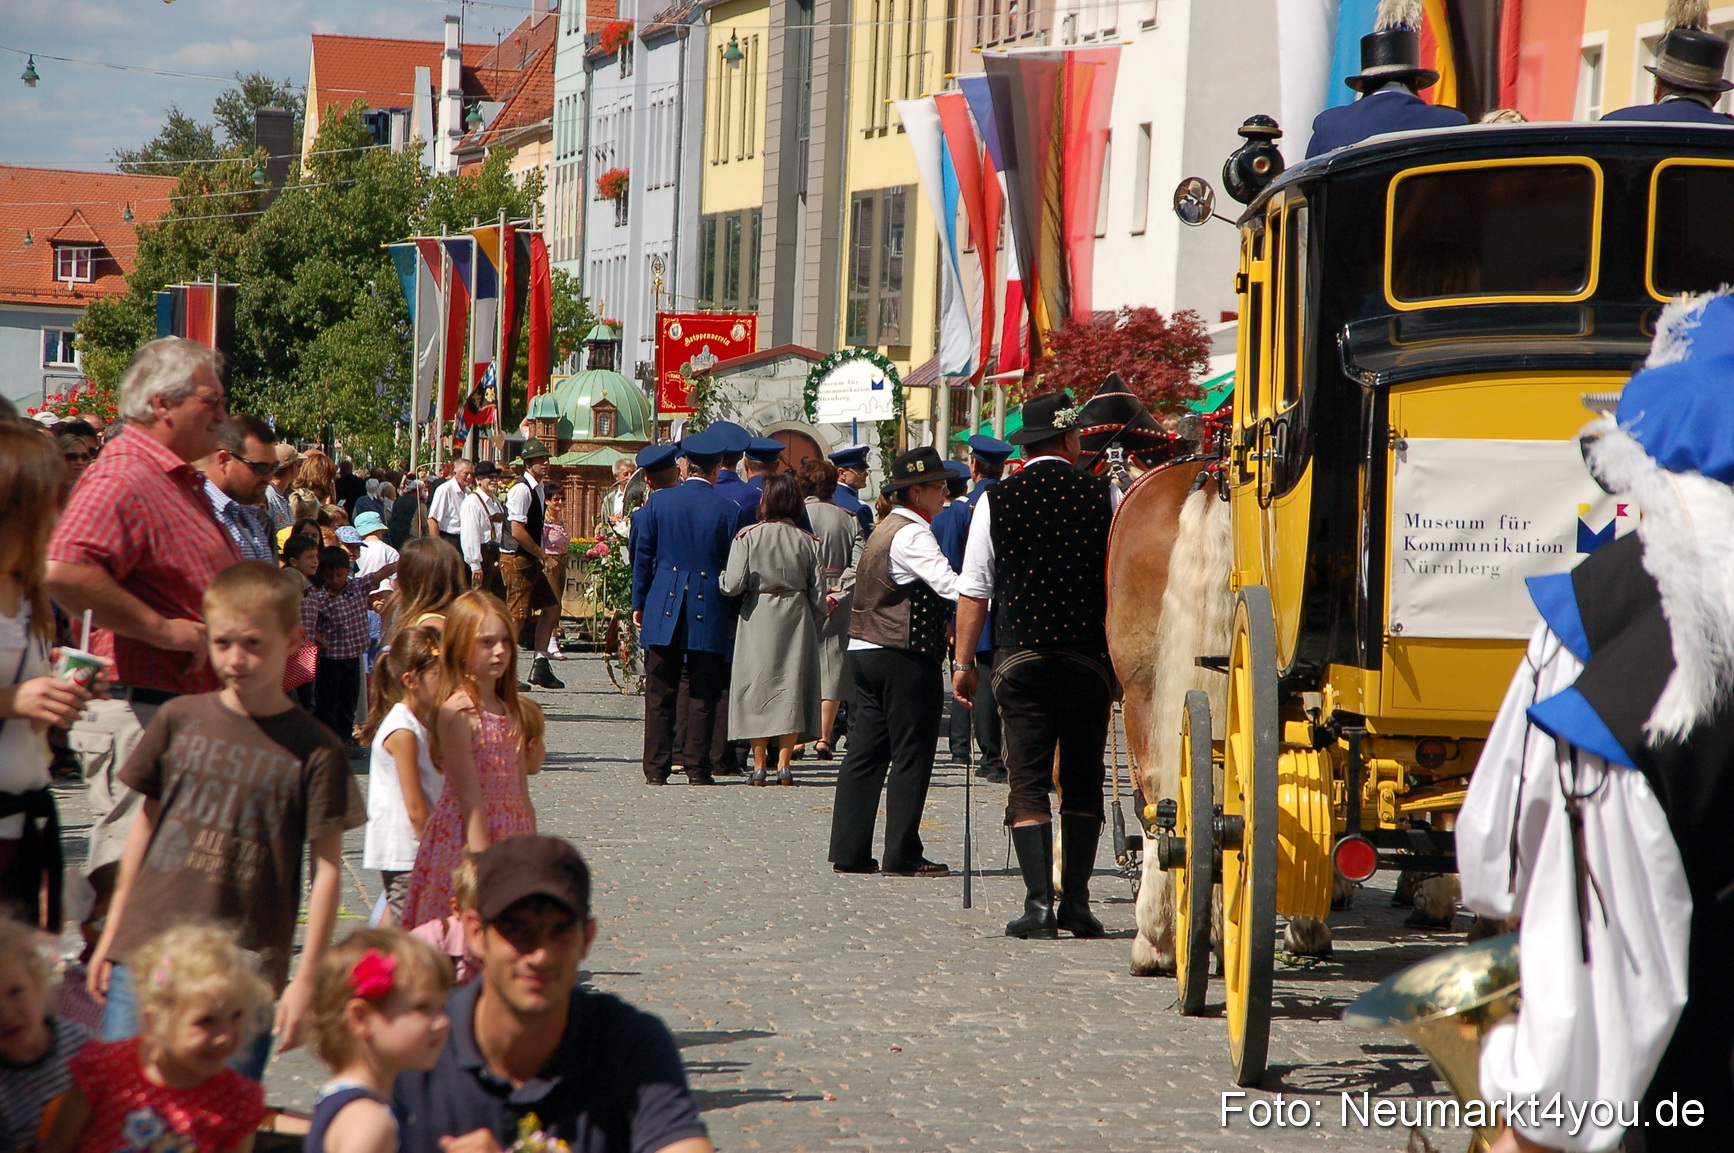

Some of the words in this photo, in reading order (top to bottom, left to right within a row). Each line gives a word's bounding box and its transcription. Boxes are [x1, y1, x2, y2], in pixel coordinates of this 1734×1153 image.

[1404, 513, 1485, 530] Museum
[1499, 514, 1532, 530] für
[1403, 535, 1564, 553] Kommunikation
[1402, 558, 1501, 581] Nürnberg
